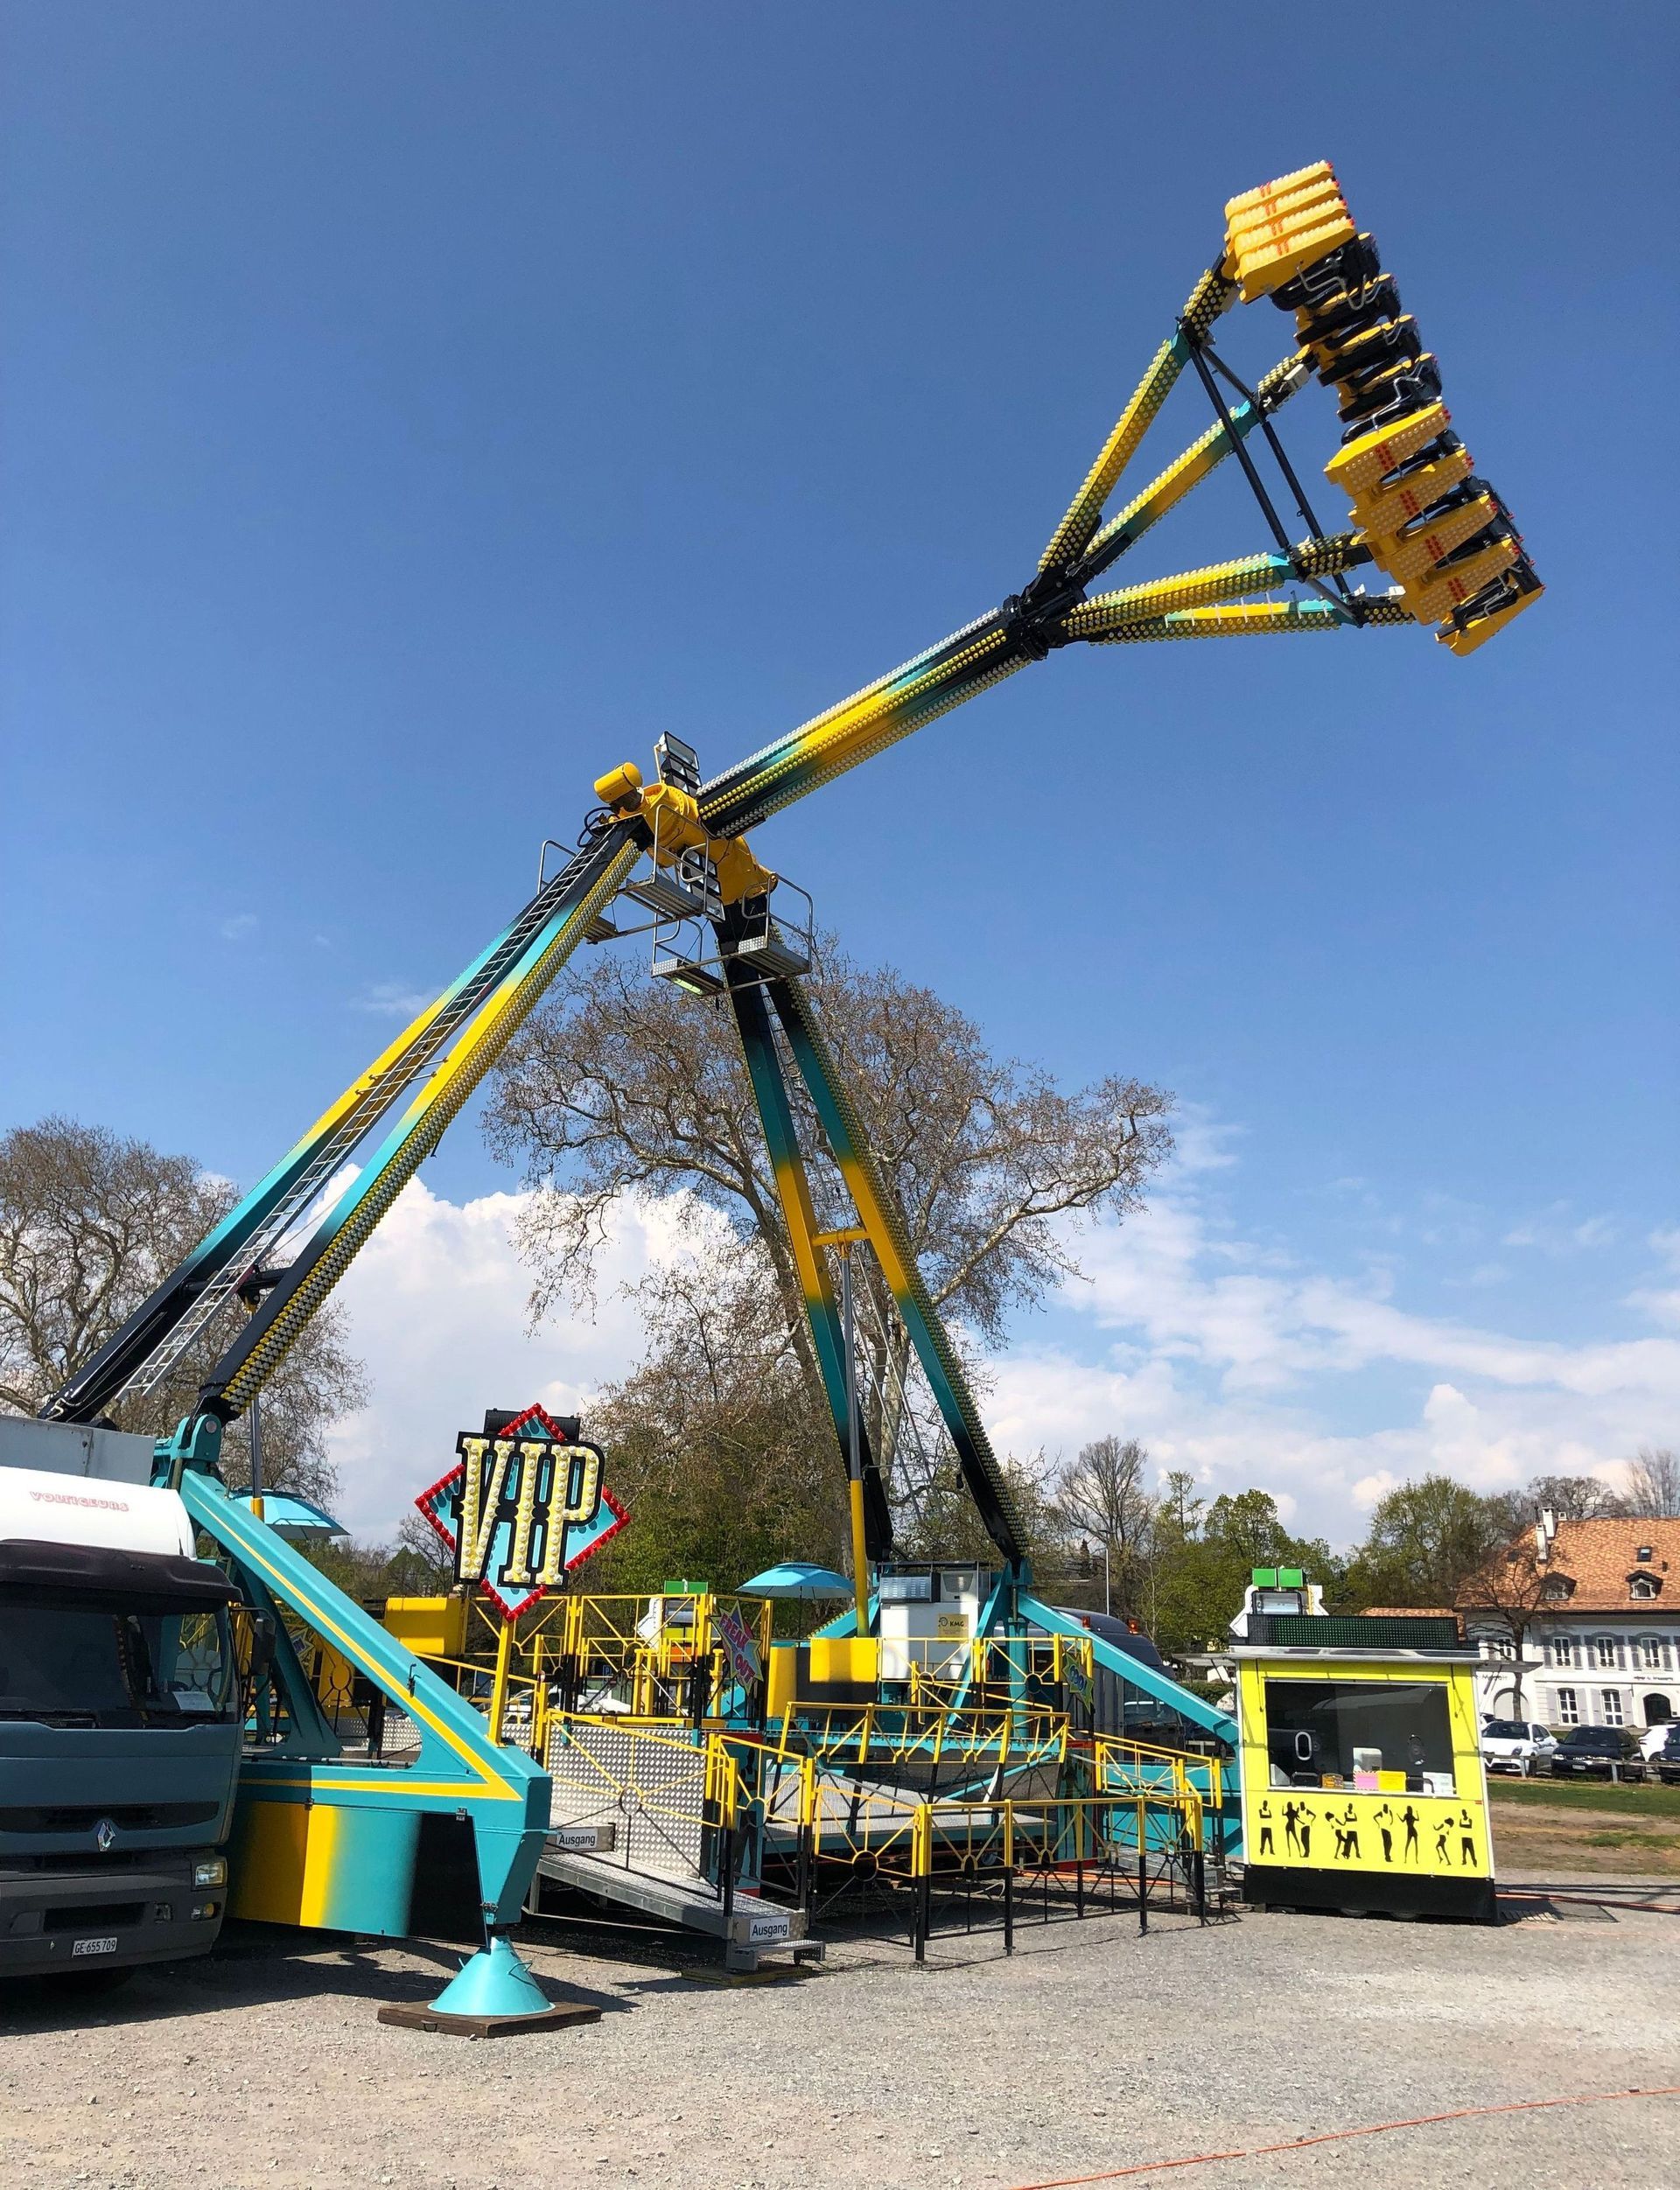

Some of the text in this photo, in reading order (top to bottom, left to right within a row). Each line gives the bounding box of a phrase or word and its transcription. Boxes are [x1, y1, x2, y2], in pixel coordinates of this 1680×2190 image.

[458, 1435, 602, 1587] VIP
[734, 1653, 757, 1683] OUT
[558, 1833, 596, 1846] Ausgang
[752, 1924, 788, 1938] Ausgang
[75, 1940, 116, 1954] GE 655 709
